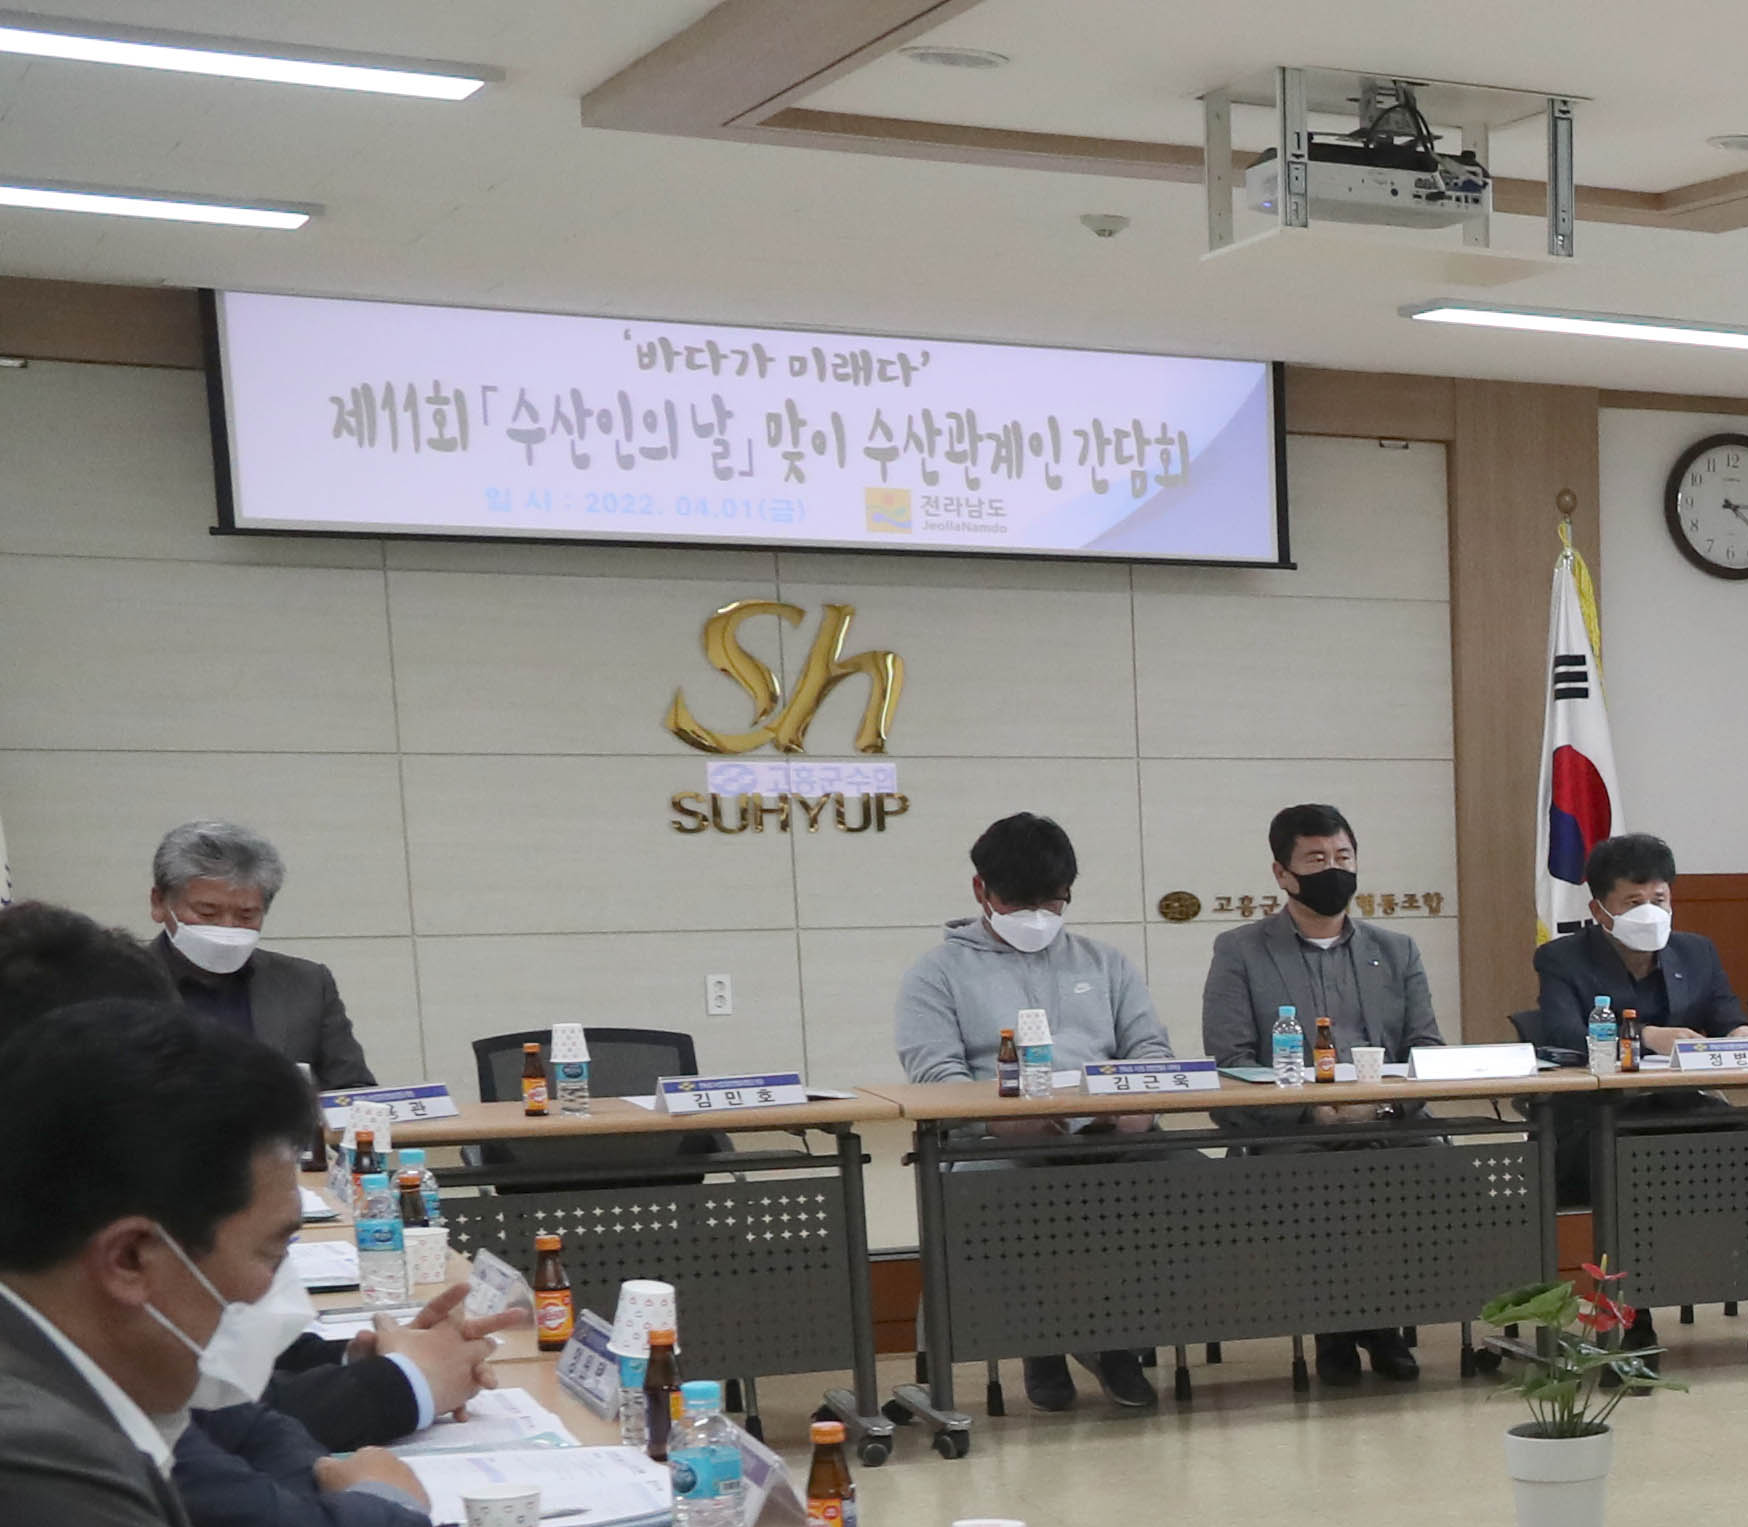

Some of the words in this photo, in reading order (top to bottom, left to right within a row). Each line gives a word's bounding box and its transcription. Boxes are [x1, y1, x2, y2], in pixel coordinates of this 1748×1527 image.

[765, 398, 846, 483] 맞이
[863, 407, 1062, 491] 수산관계인
[1073, 418, 1191, 498] 간담회
[1707, 458, 1716, 472] 11
[1726, 454, 1739, 468] 12
[1690, 473, 1702, 487] 10
[920, 495, 1007, 519] 전라남도
[1706, 538, 1714, 553] 7
[1726, 545, 1735, 560] 6
[665, 599, 904, 754] Sh
[671, 792, 911, 834] SUHYUP
